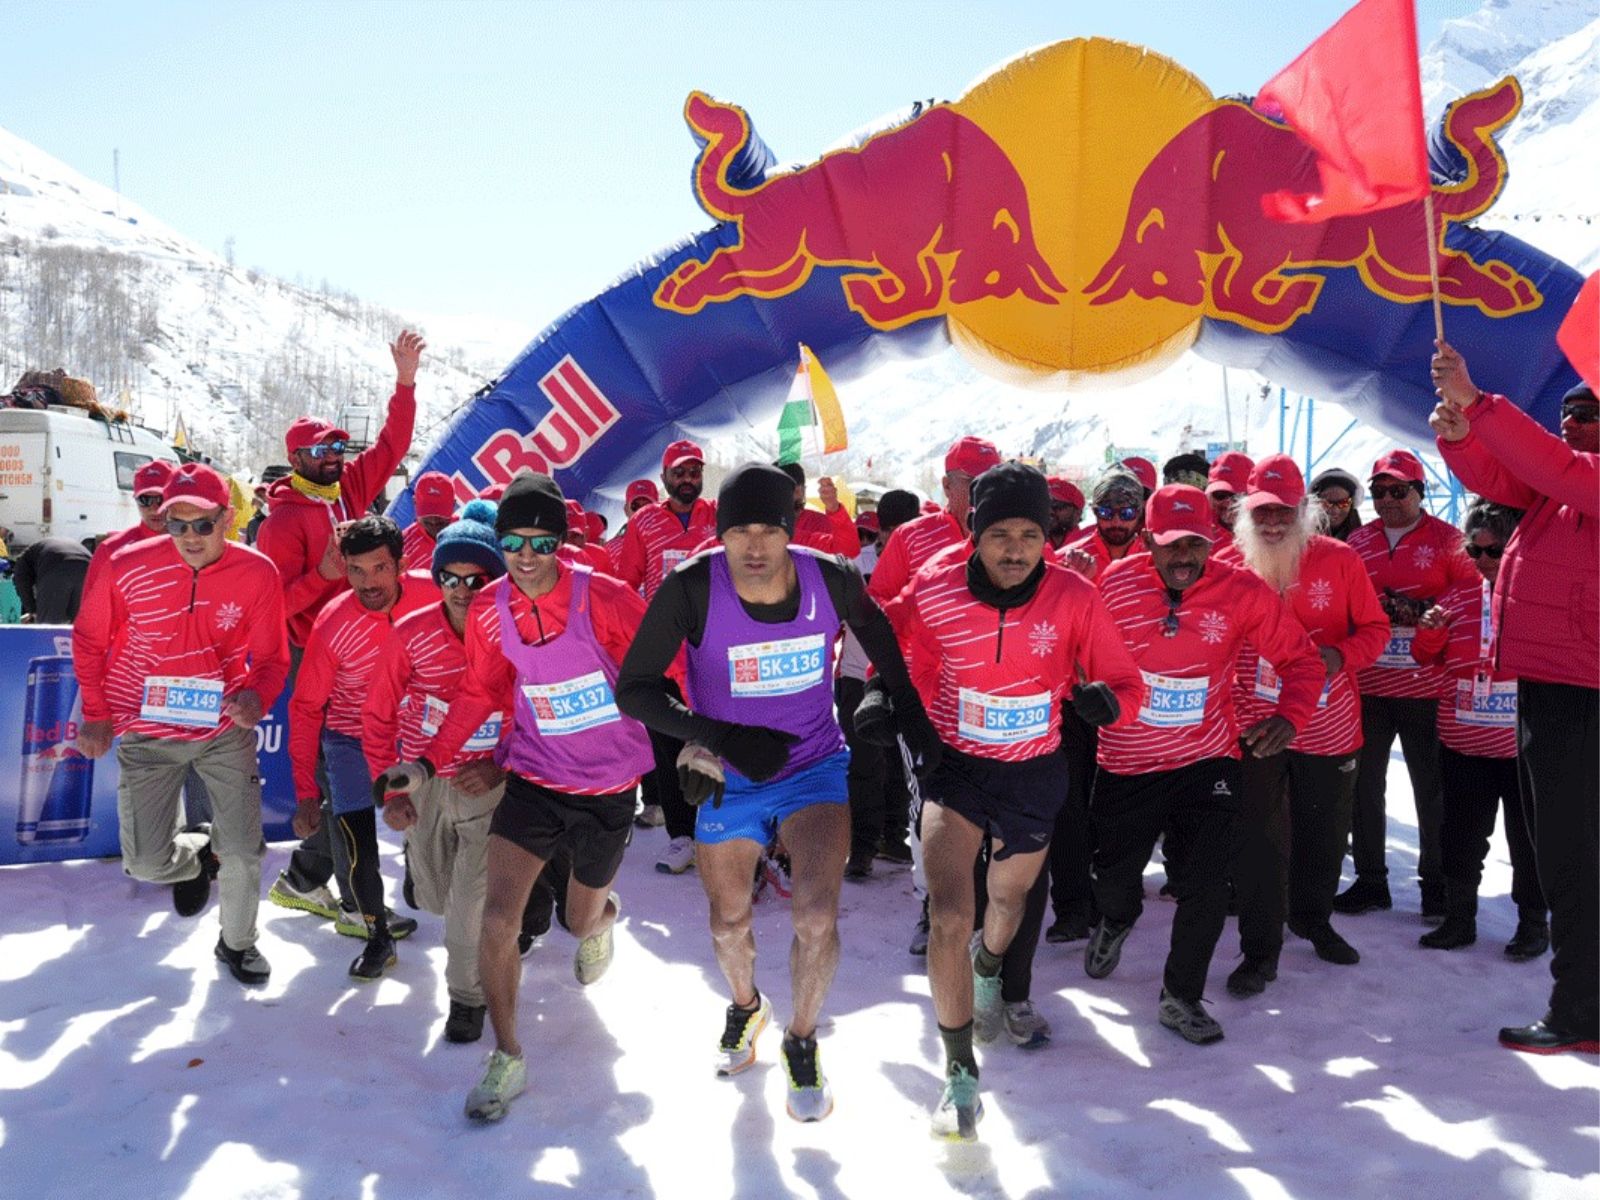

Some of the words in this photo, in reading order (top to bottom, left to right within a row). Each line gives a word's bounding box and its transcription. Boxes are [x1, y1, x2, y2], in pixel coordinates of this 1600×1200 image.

[471, 353, 622, 485] Bull
[761, 652, 820, 677] 5K-136
[168, 690, 217, 709] 5K-149
[552, 687, 606, 716] 5K-137
[1152, 691, 1203, 709] 5K-158
[987, 708, 1045, 727] 5K-230
